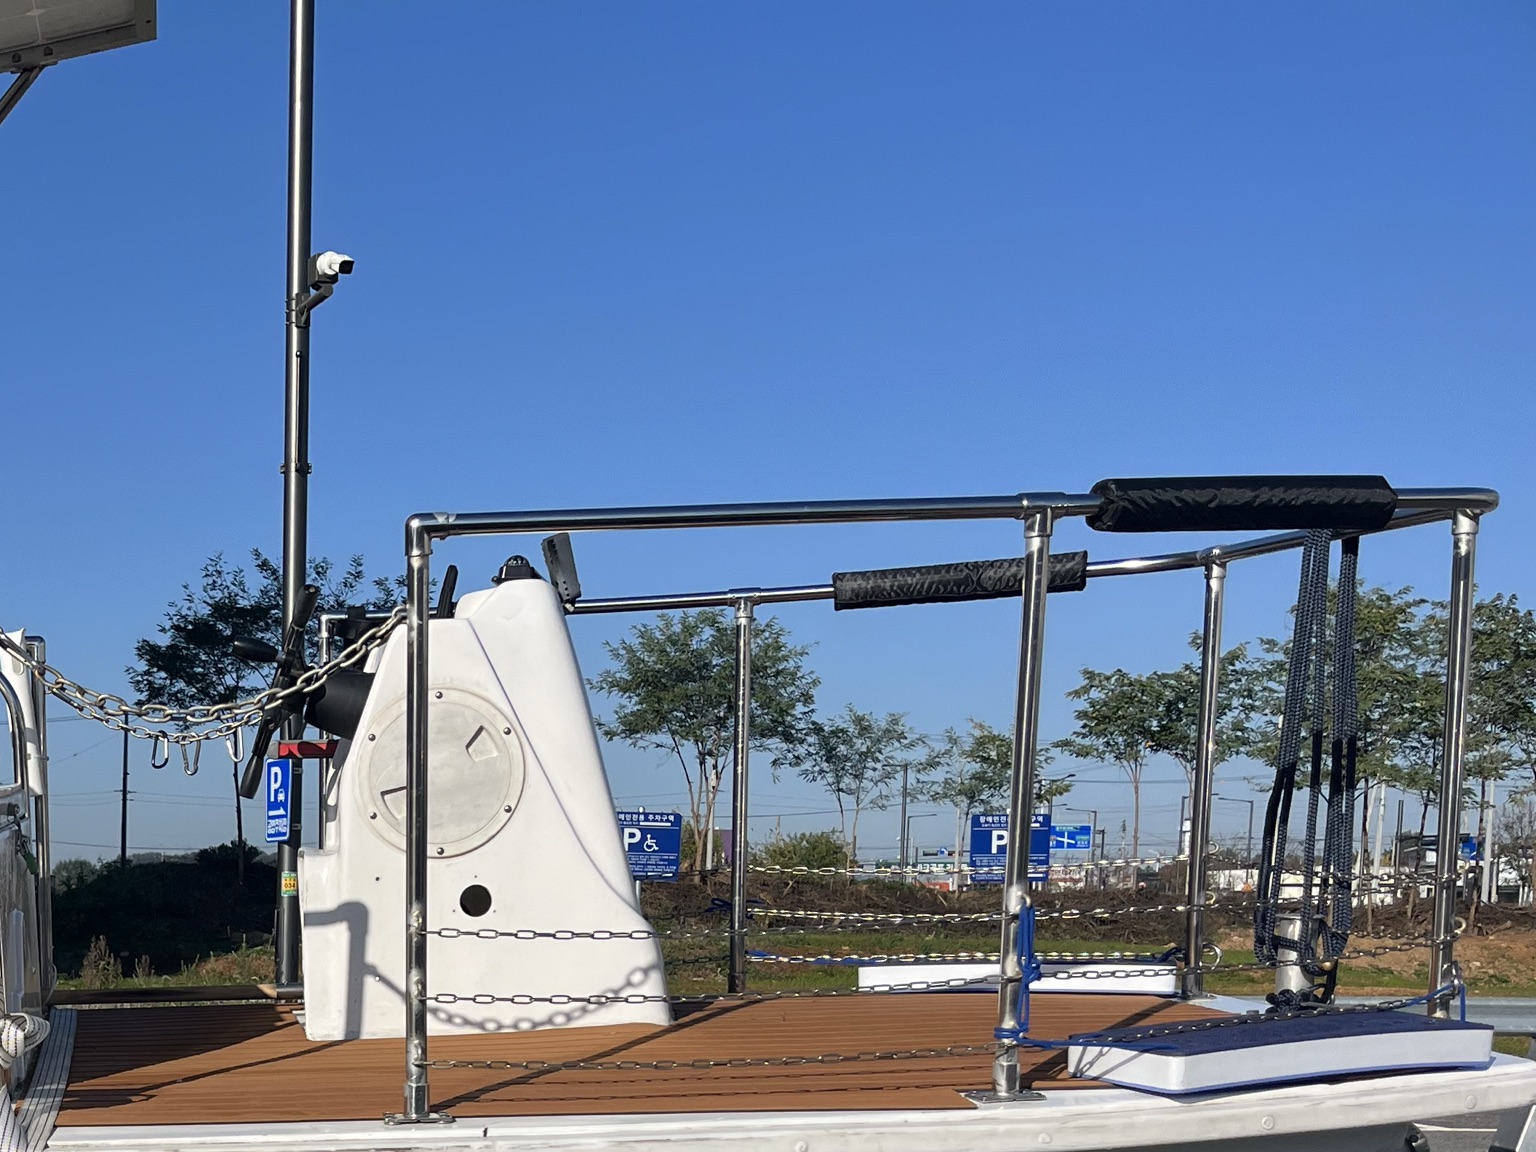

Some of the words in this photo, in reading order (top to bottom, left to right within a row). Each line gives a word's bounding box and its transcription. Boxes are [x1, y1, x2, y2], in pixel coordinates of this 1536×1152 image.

[270, 766, 282, 802] P
[648, 814, 675, 822] 주차구역
[979, 815, 1007, 823] 장애인전
[623, 827, 642, 852] P
[991, 830, 1008, 854] P
